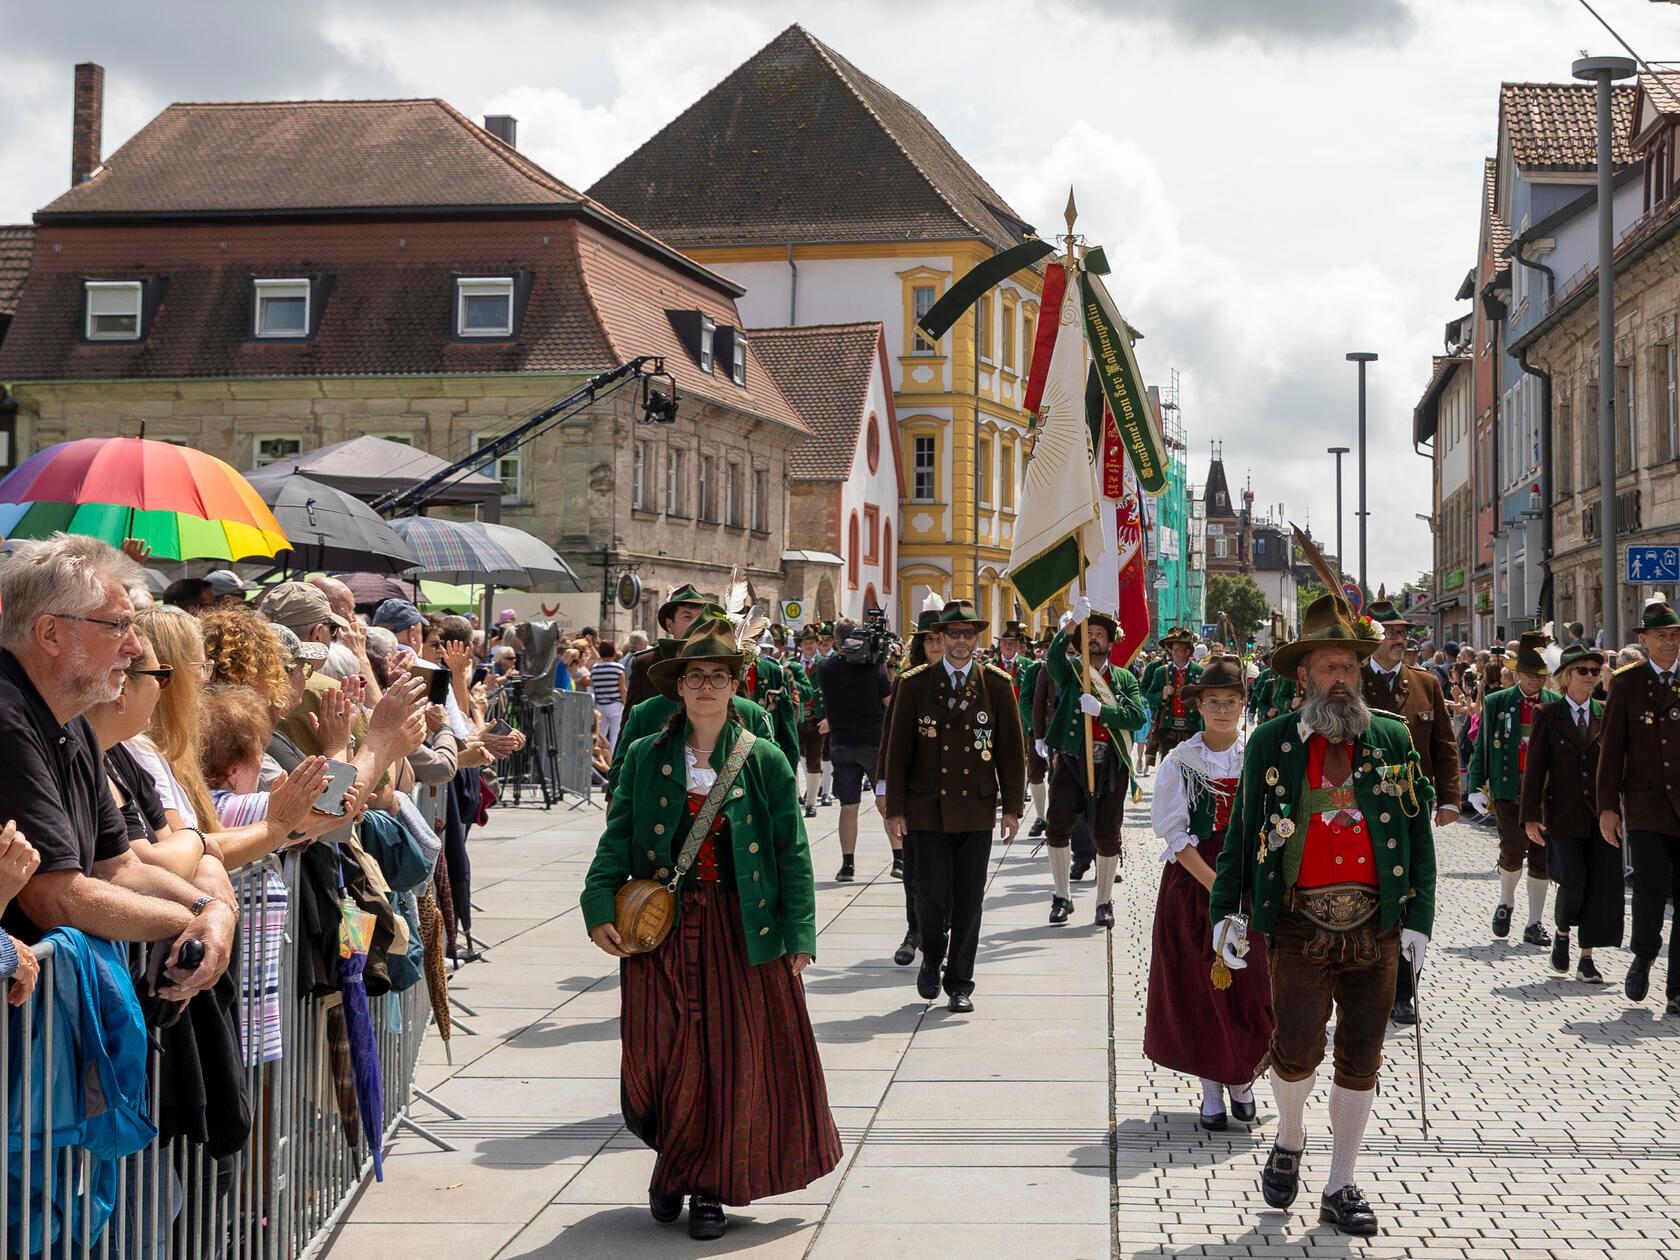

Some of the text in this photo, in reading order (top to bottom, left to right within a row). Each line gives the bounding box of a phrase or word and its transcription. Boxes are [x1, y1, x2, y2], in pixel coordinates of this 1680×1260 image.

[1112, 377, 1127, 398] der
[1120, 399, 1134, 420] von
[1124, 421, 1154, 479] Gewidmet
